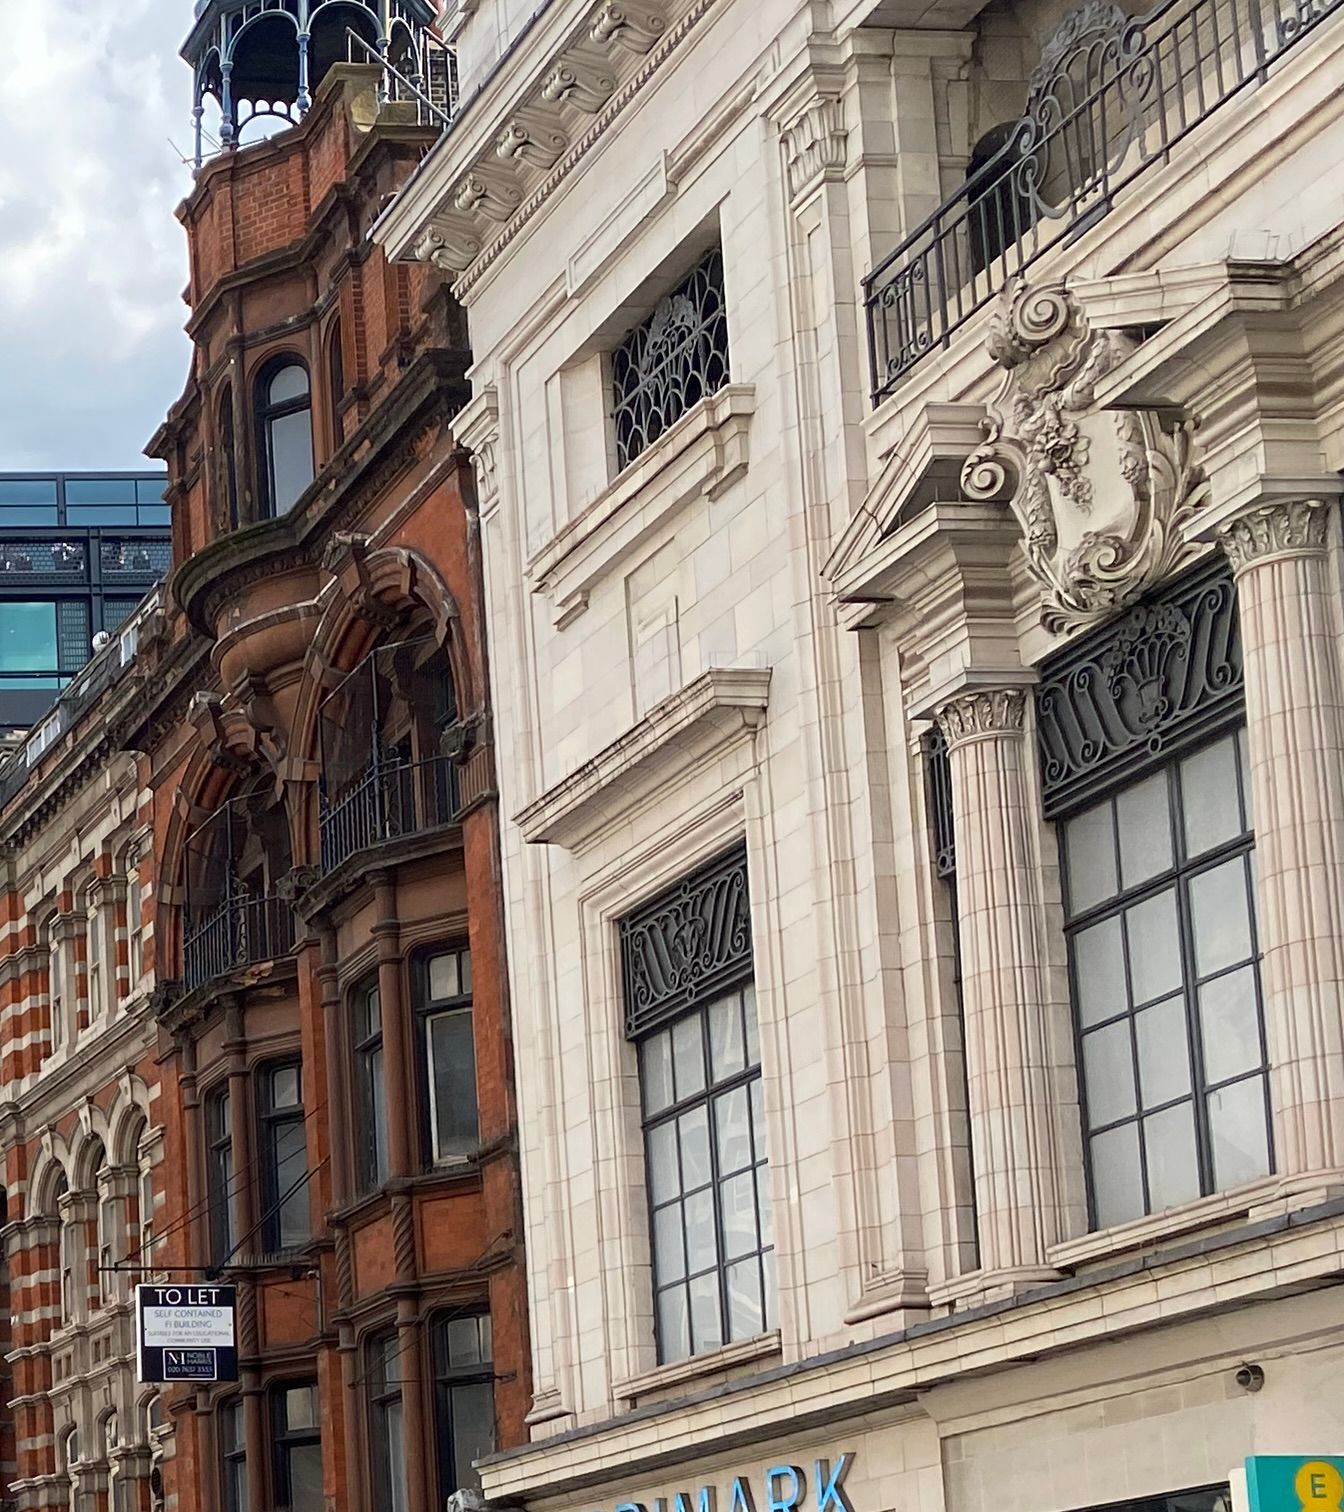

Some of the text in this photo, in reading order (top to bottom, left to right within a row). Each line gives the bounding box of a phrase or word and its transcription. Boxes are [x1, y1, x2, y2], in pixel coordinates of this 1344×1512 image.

[154, 1288, 220, 1305] TO LET
[154, 1310, 223, 1318] SELF CONTAINED
